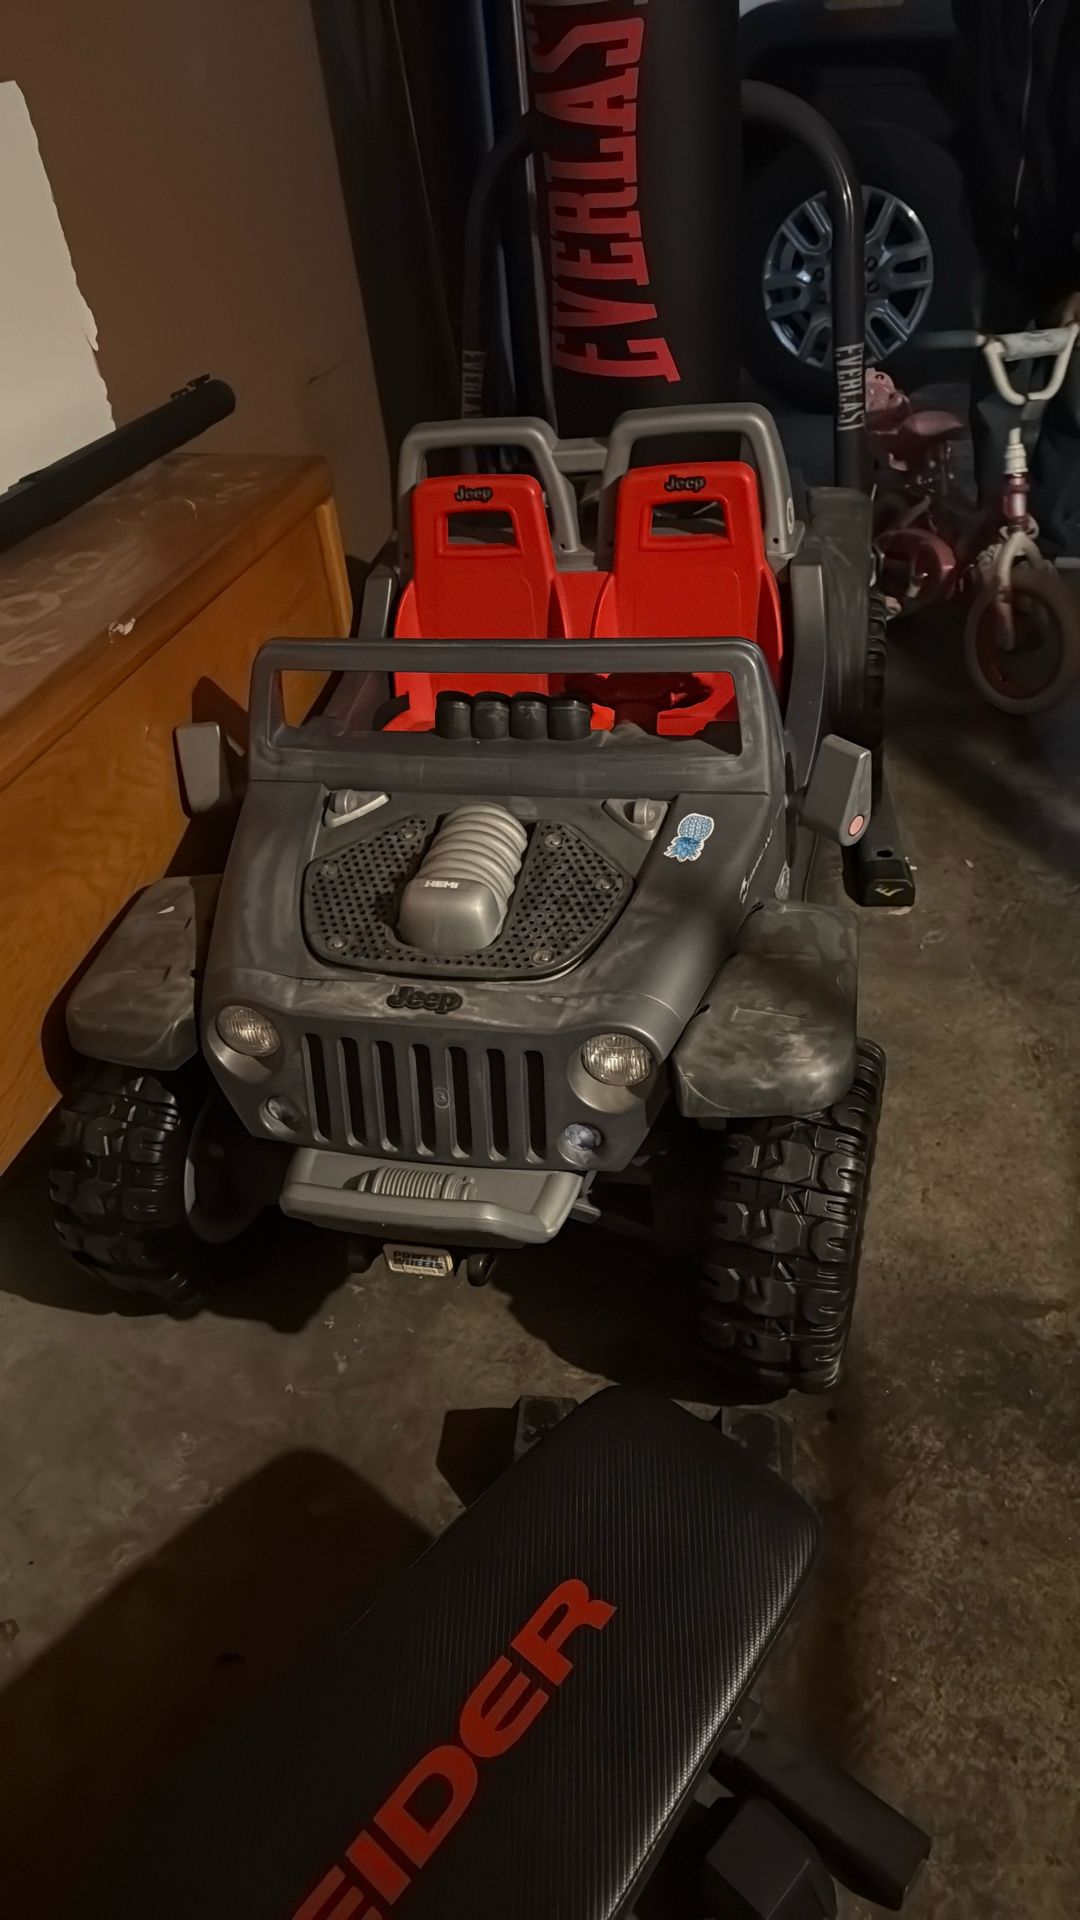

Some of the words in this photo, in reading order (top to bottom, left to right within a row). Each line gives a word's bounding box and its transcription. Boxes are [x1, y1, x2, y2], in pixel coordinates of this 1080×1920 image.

[529, 0, 681, 382] EVERLAS
[663, 475, 705, 492] Jeep
[455, 485, 493, 502] Jeep
[424, 880, 459, 889] HEMI
[386, 985, 464, 1014] Jeep
[393, 1251, 440, 1262] POWER
[393, 1258, 443, 1269] WHEELS
